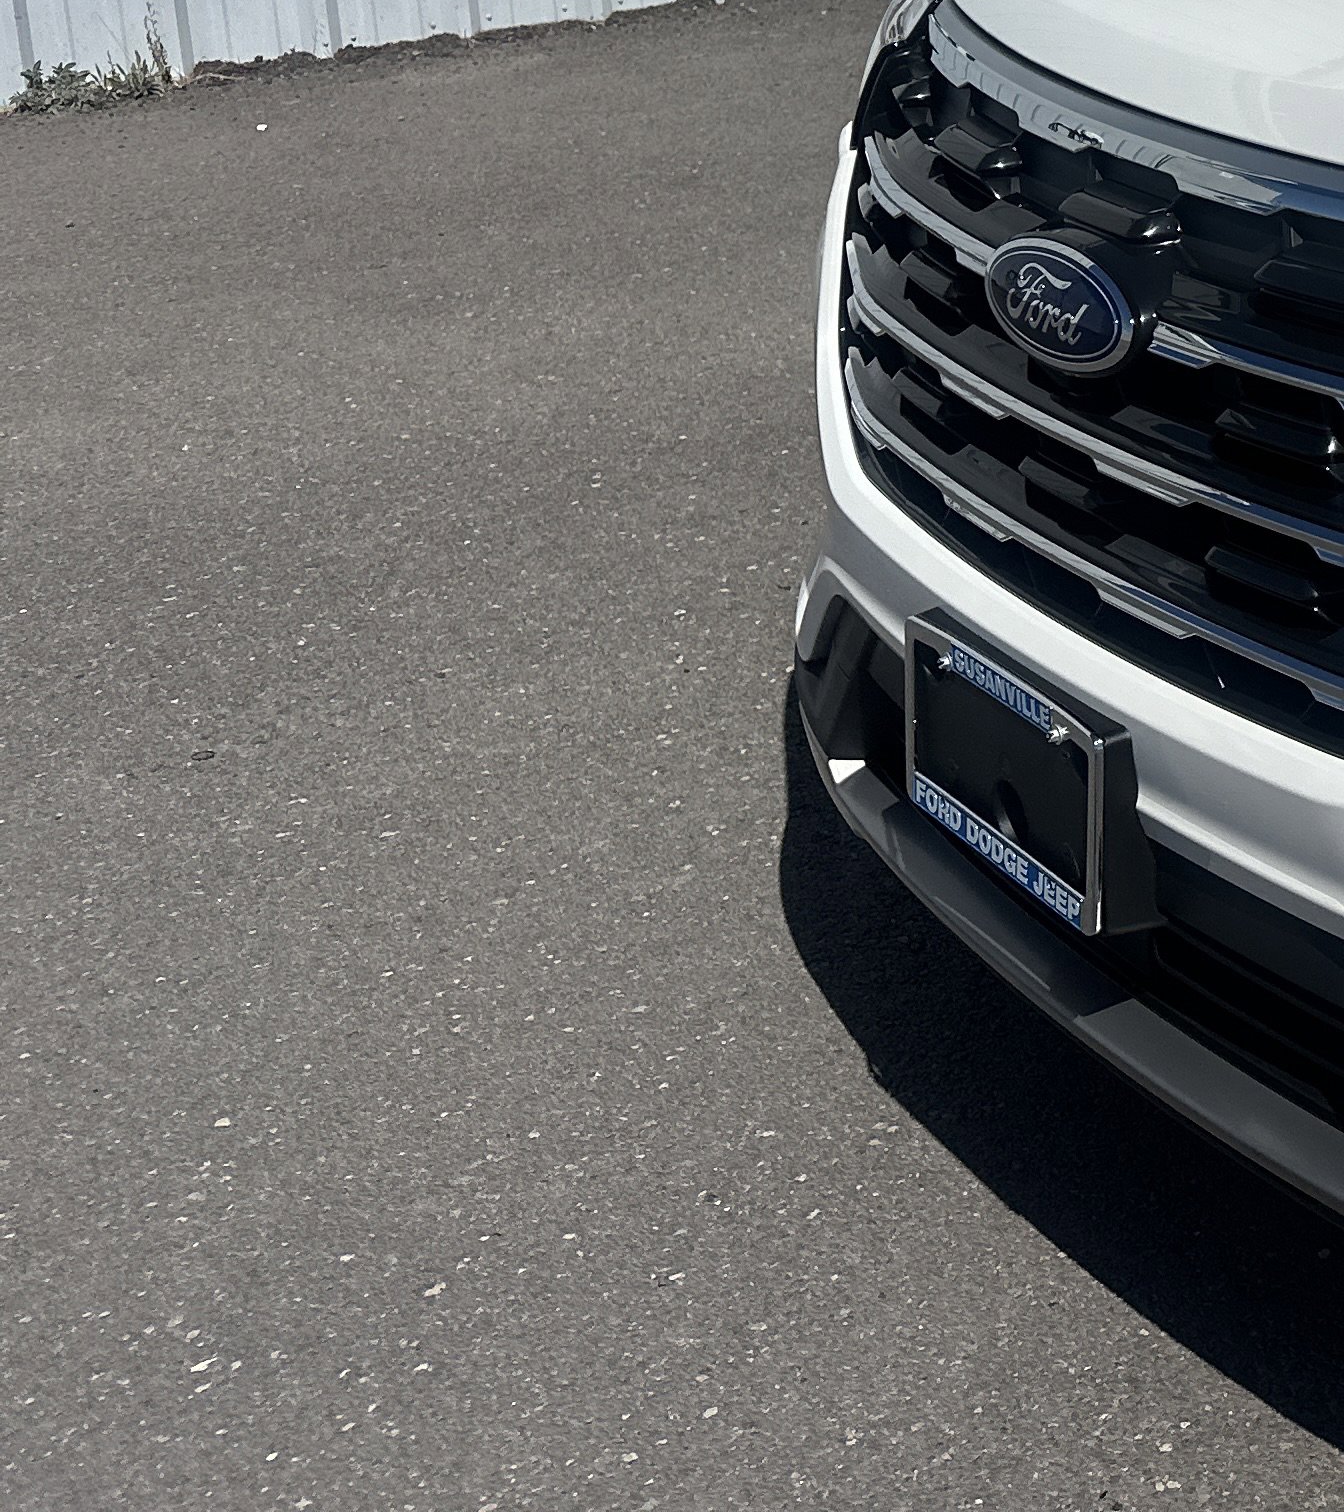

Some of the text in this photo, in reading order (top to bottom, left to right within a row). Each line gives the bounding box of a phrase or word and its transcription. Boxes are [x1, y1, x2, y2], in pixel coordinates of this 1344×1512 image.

[1006, 262, 1090, 346] Ford
[953, 648, 1052, 729] SUSANVILLE
[915, 781, 1081, 922] FORD DODGE JEEP
